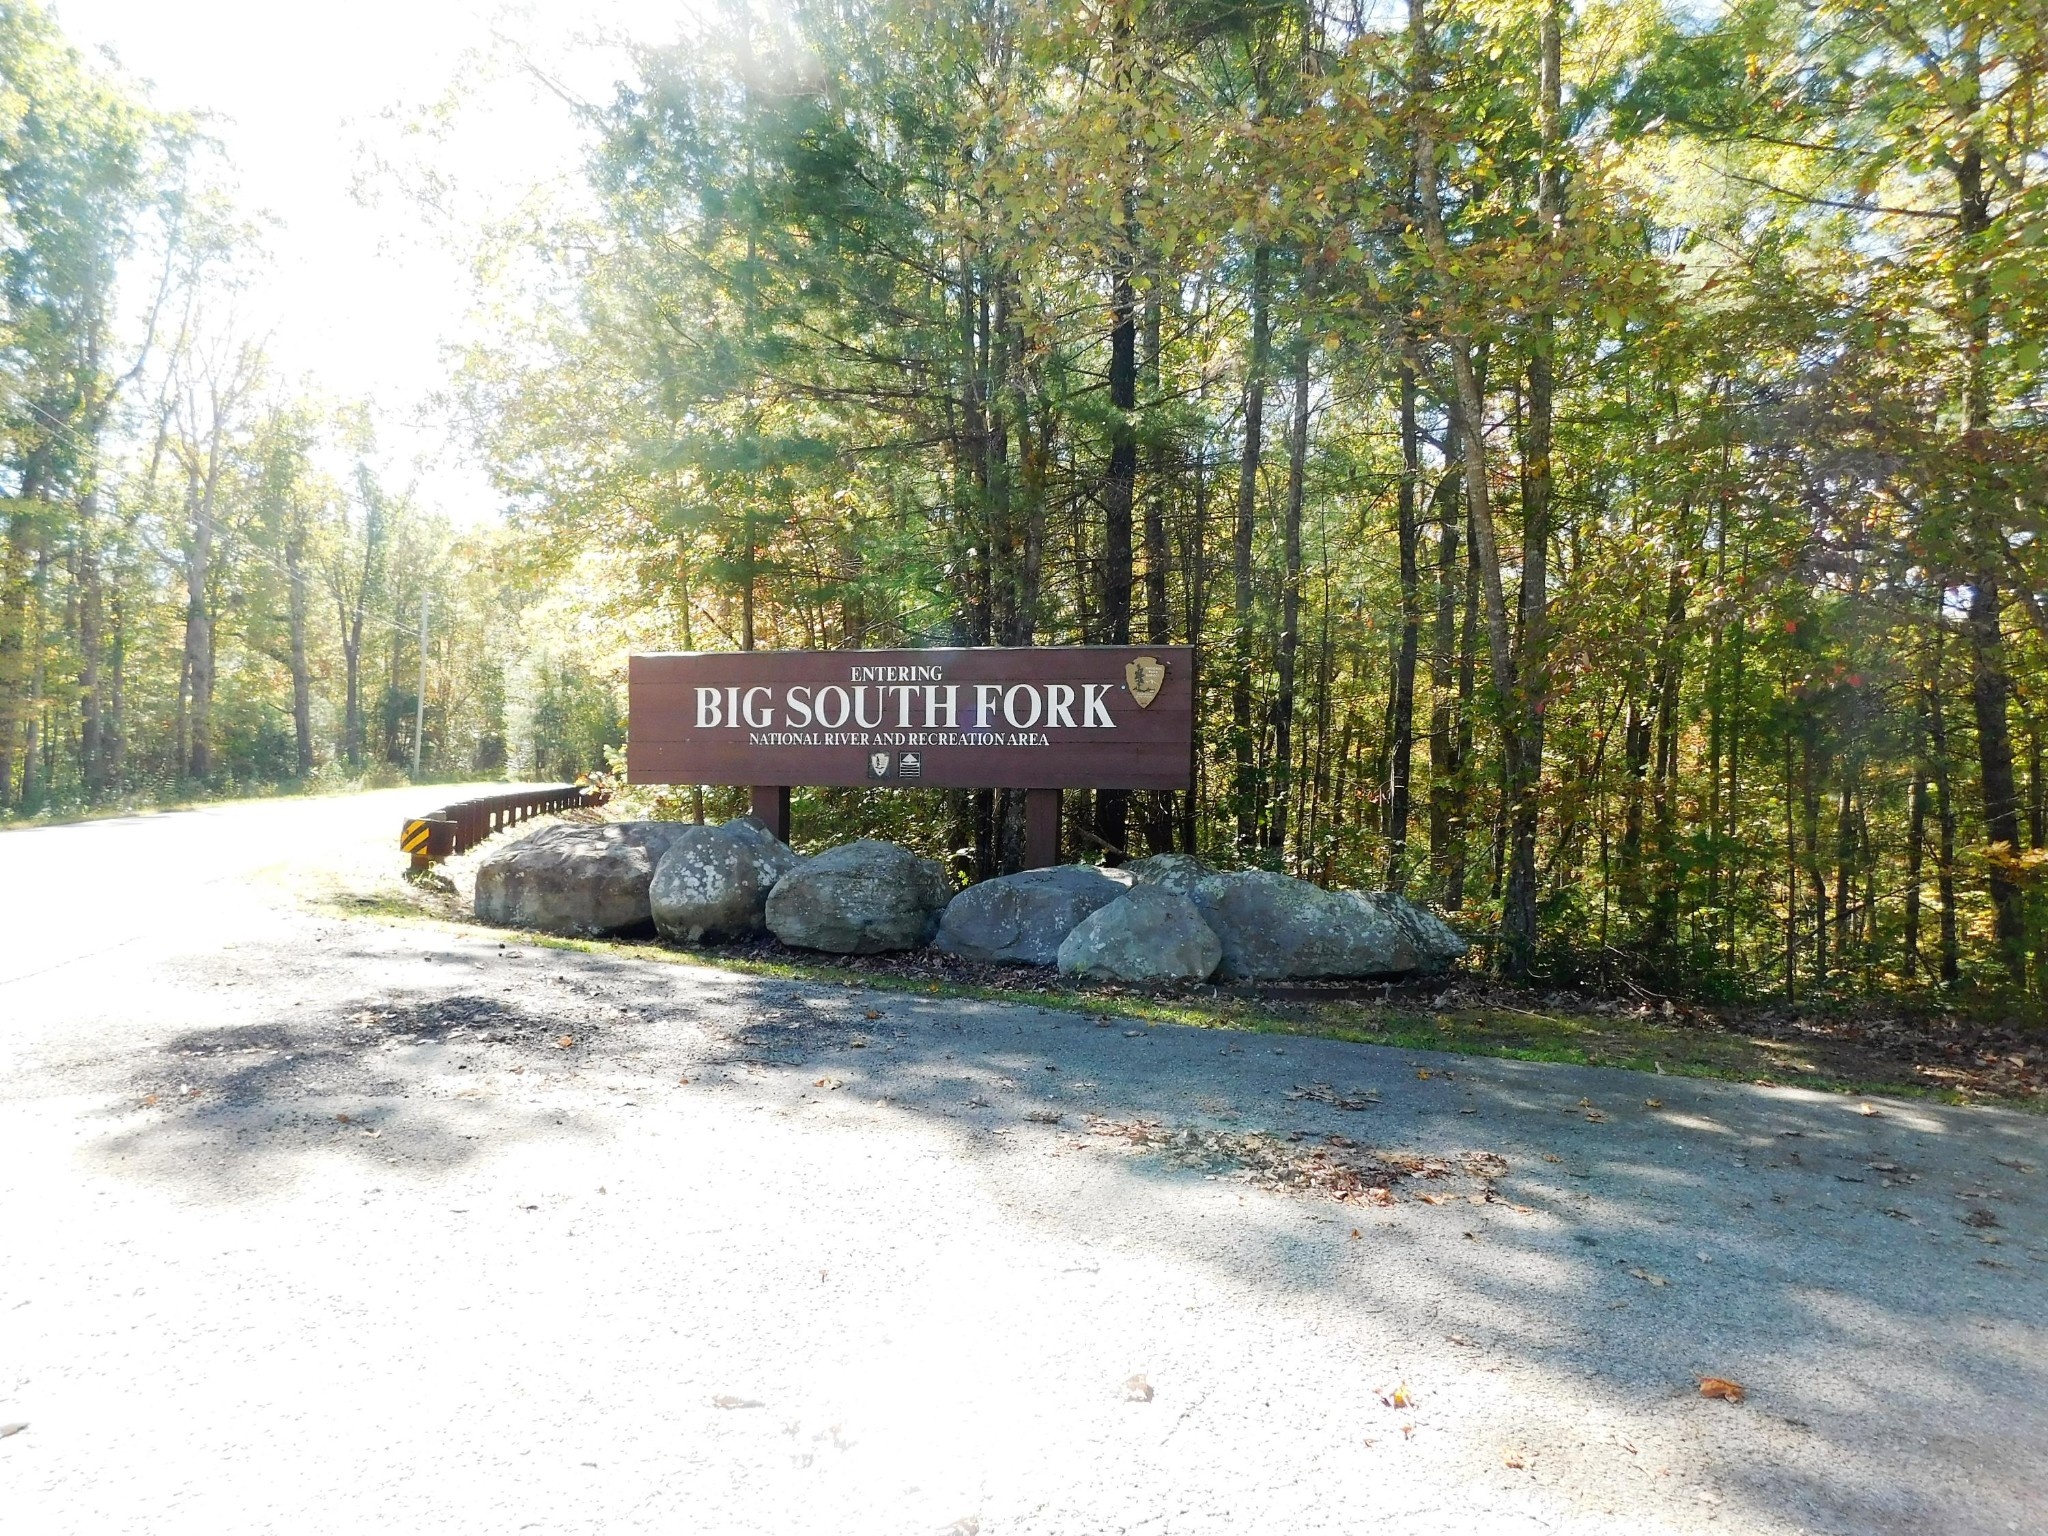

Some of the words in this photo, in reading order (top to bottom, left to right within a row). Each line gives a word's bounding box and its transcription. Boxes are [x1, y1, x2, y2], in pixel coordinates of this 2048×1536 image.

[851, 666, 942, 681] ENTERING
[694, 687, 775, 728] BIG
[786, 685, 960, 728] SOUTH
[973, 684, 1116, 728] FORK
[750, 733, 821, 745] NATIONAL
[825, 733, 869, 745] RIVER
[873, 733, 905, 745] AND
[909, 733, 1005, 745] RECREATION
[1007, 733, 1049, 745] AREA
